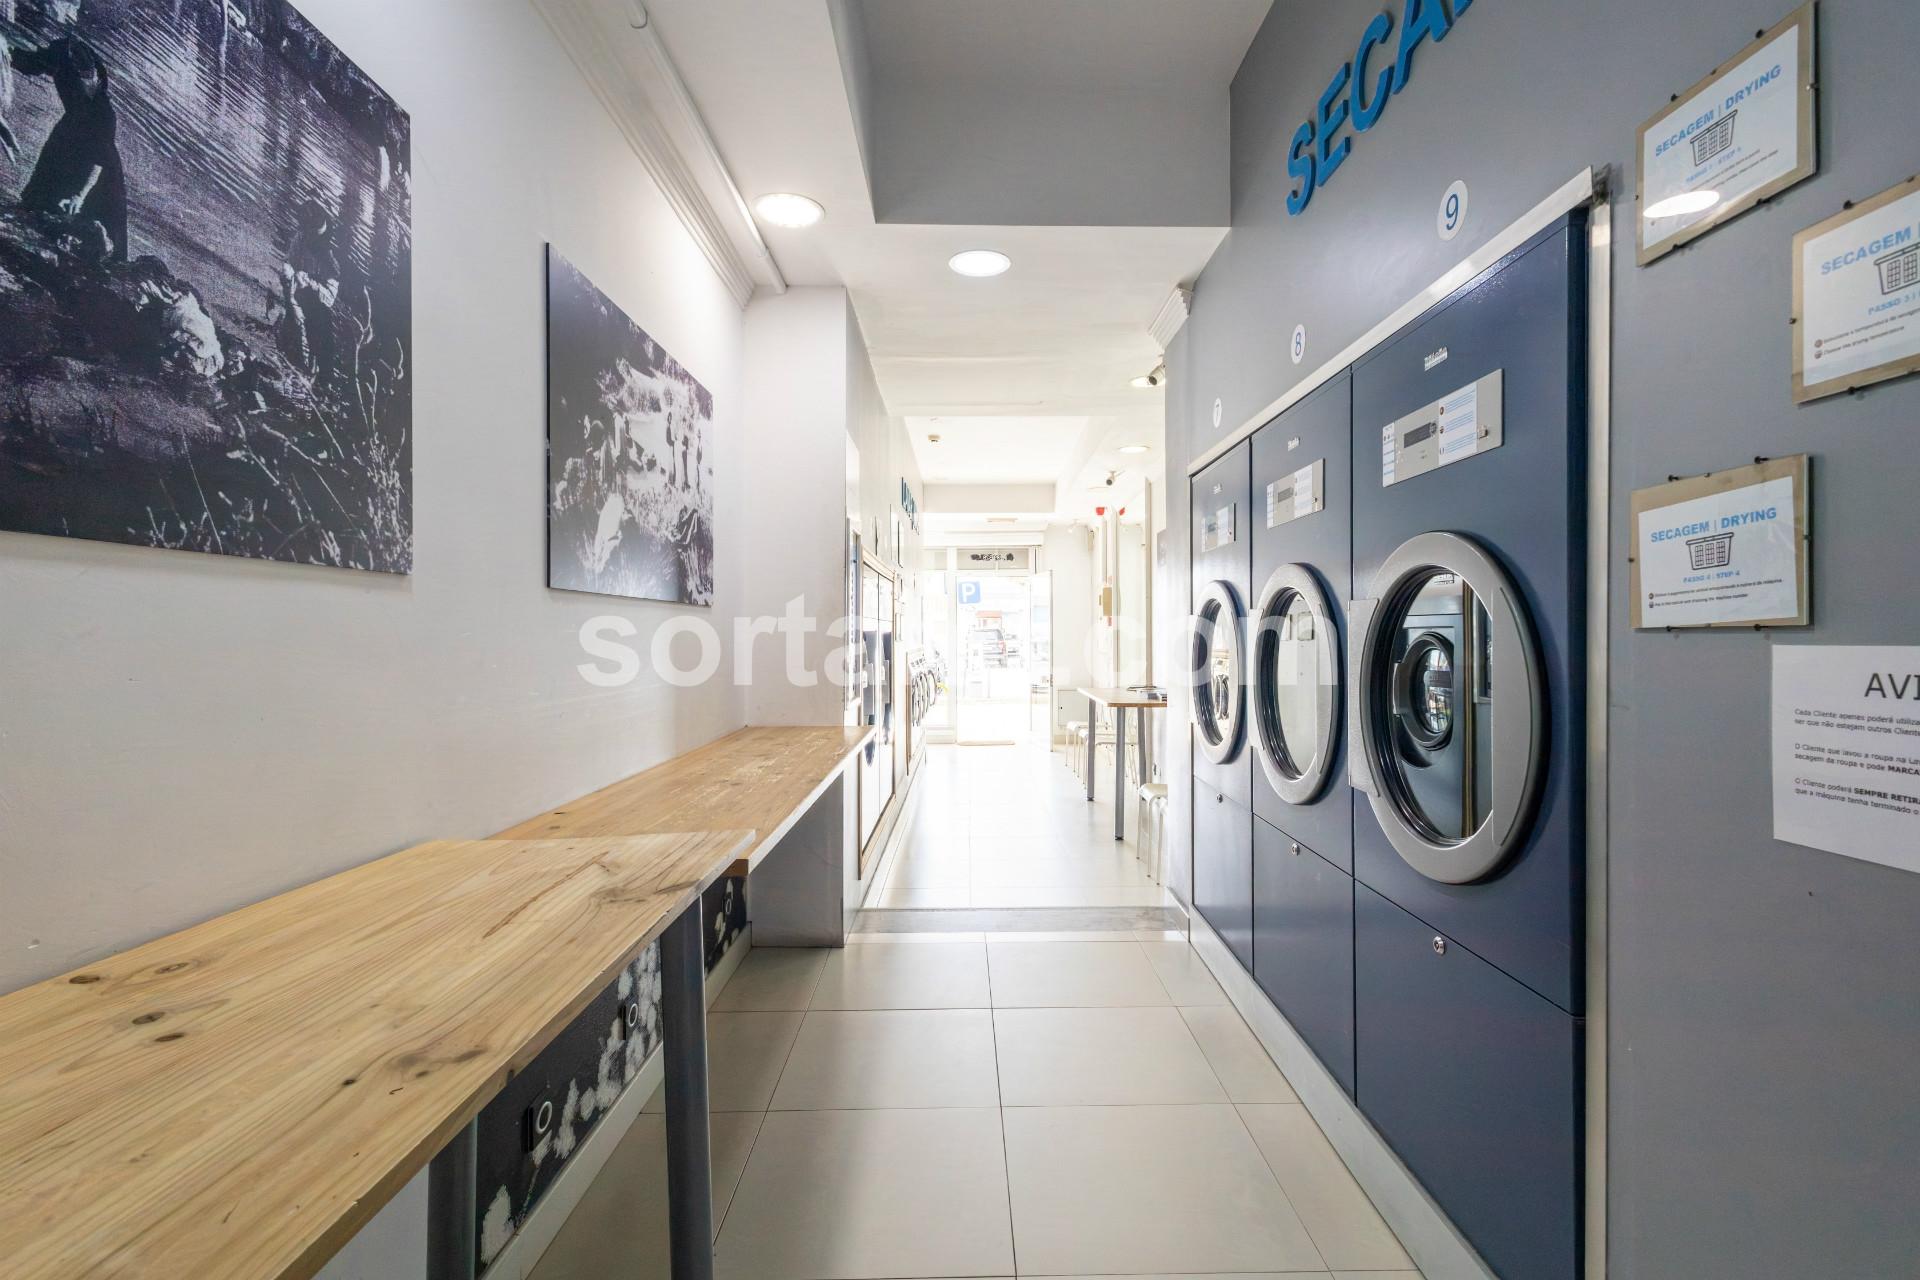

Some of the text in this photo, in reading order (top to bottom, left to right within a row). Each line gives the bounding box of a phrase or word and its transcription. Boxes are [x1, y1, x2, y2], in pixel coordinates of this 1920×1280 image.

[1286, 0, 1474, 216] SECA
[1655, 109, 1714, 157] SECAGEM
[1725, 64, 1781, 110] DRYING
[1446, 193, 1459, 231] 9
[1820, 226, 1911, 276] SECAGEM
[1295, 332, 1302, 355] 8
[1651, 521, 1710, 543] SECAGEM
[1721, 507, 1777, 529] DRYING
[1794, 708, 1812, 717] Cada
[1813, 709, 1837, 719] Cliente
[1838, 712, 1865, 722] apenas
[1867, 725, 1892, 734] outros
[1794, 753, 1824, 763] secagem
[1837, 759, 1858, 768] roupa
[1802, 743, 1825, 753] Cliente
[1871, 753, 1894, 763] roupa
[1853, 787, 1889, 800] SEMPRE
[1847, 797, 1869, 807] tenha
[1870, 801, 1912, 814] terminado
